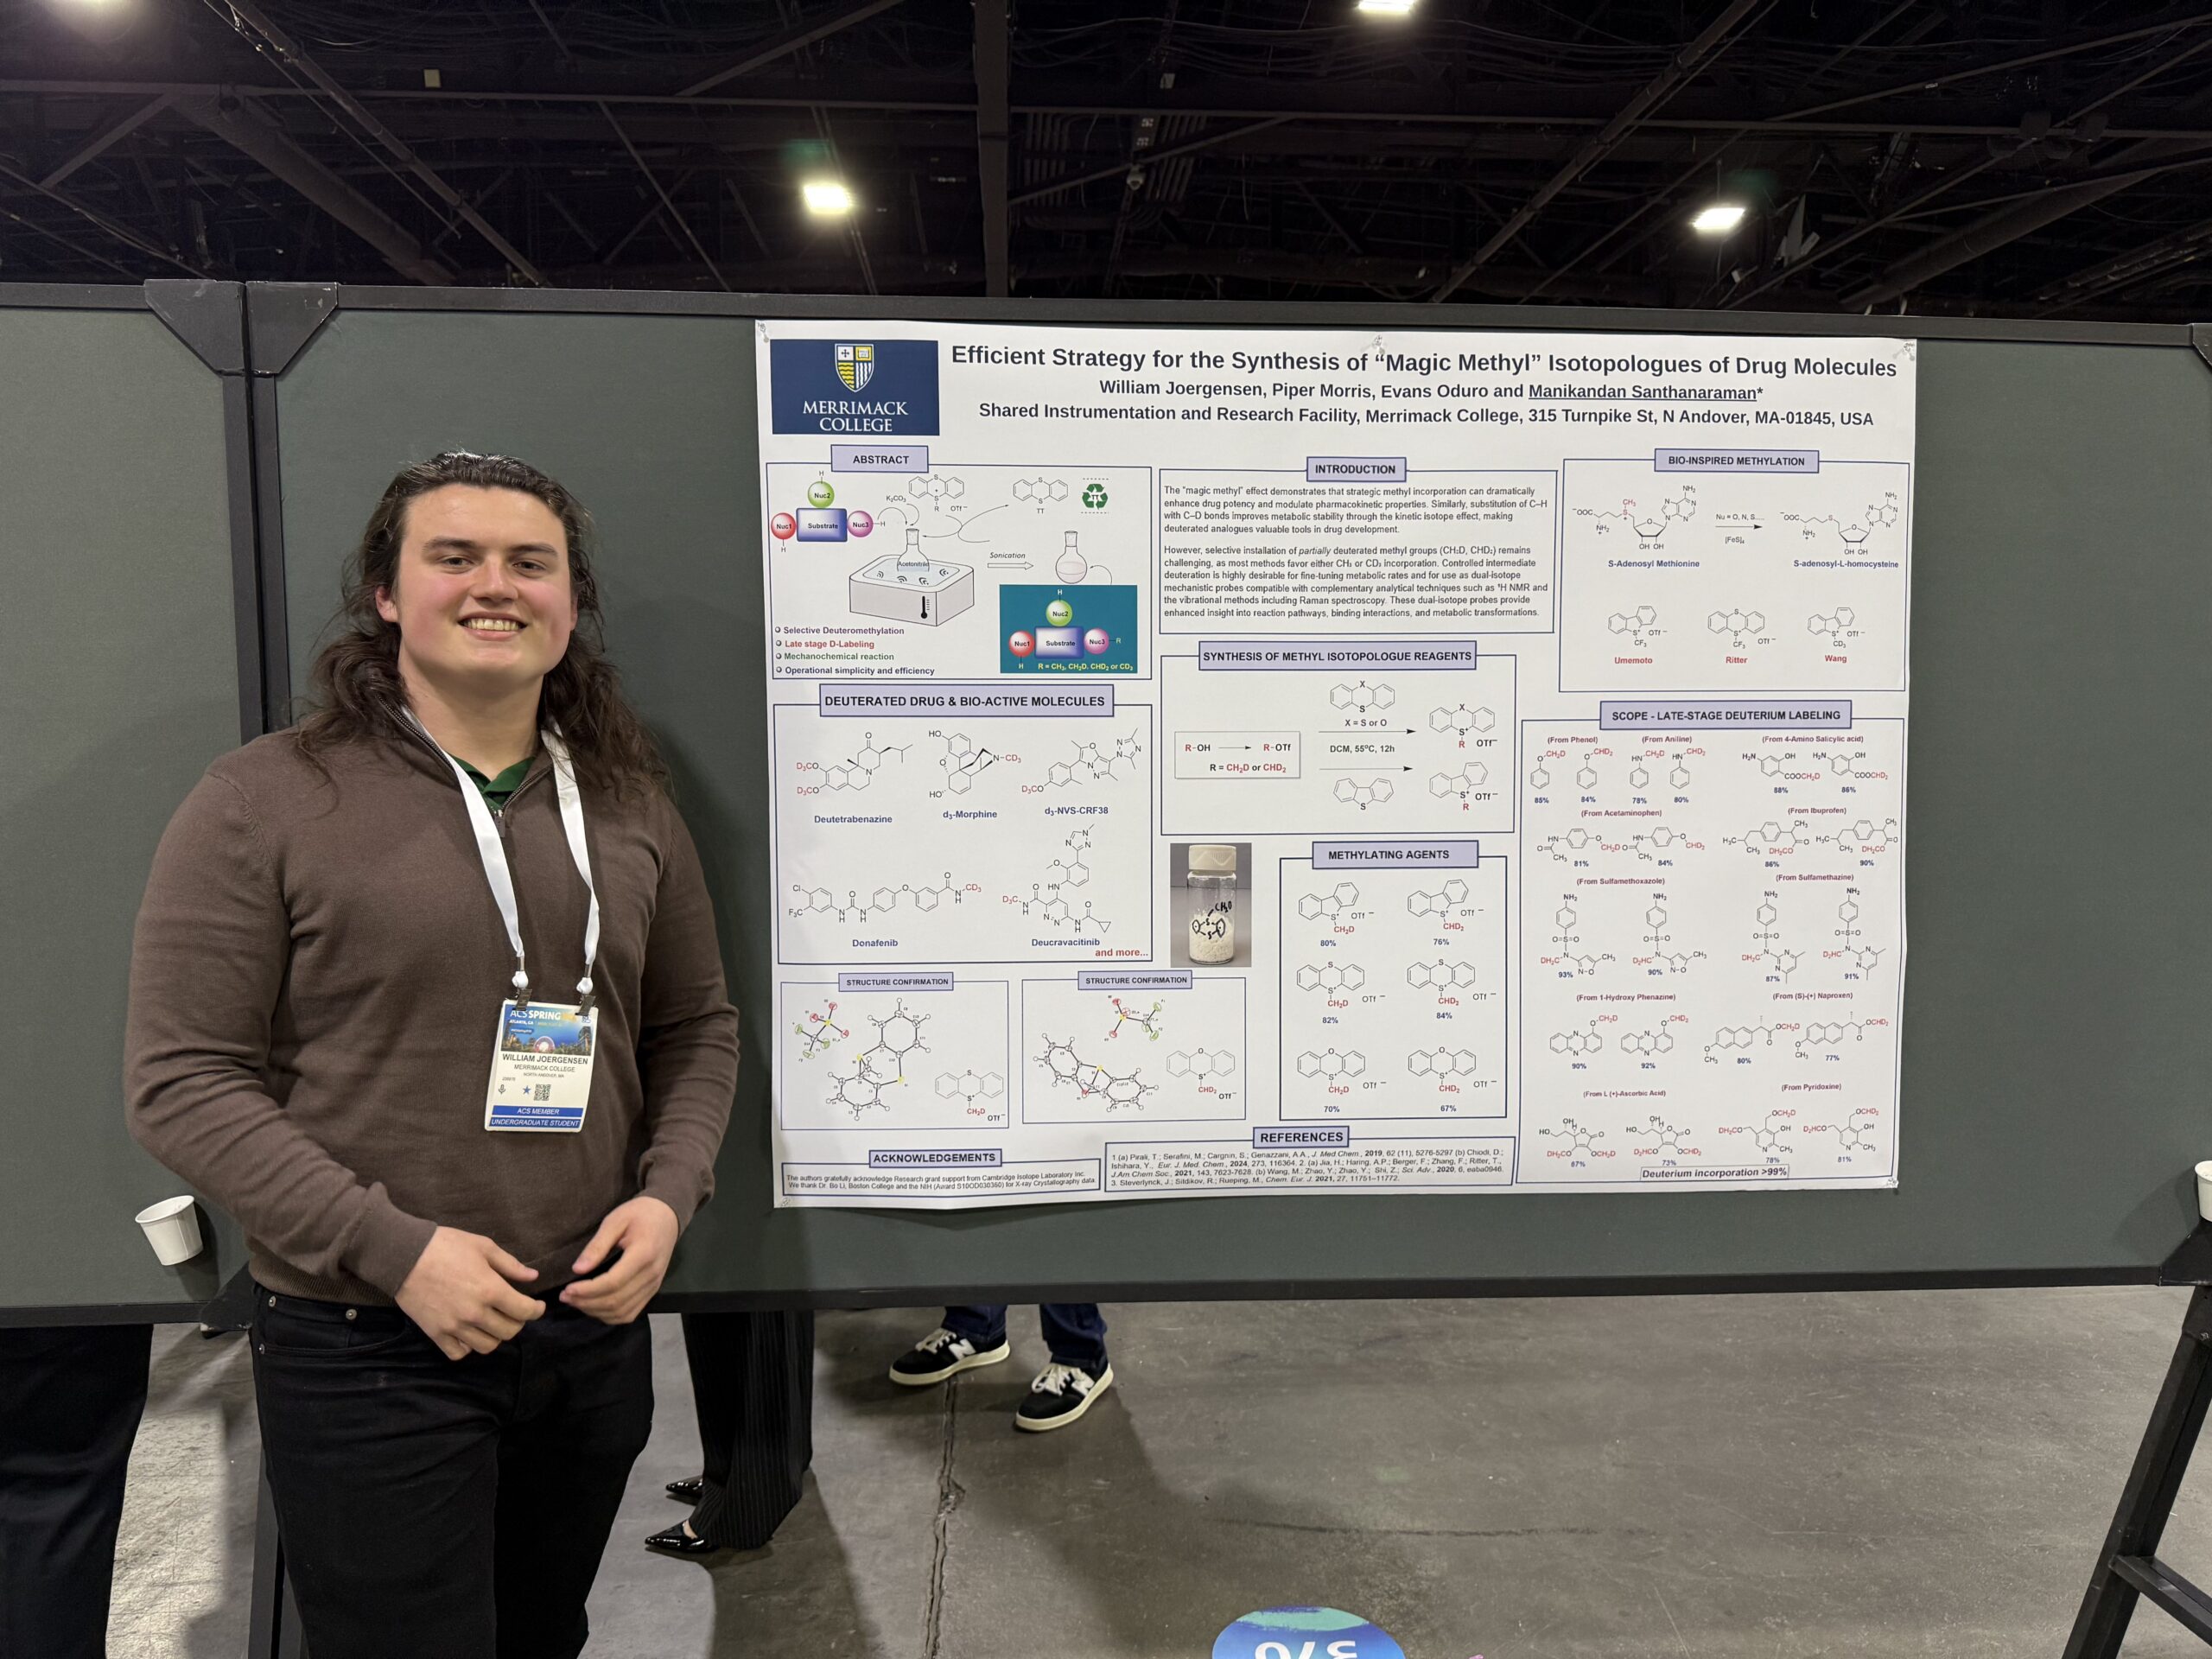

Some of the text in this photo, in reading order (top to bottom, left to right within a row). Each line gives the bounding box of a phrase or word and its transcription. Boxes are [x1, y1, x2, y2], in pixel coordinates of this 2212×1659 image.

[952, 345, 1046, 365] Efficient
[1052, 348, 1146, 372] Strategy
[1153, 349, 1183, 368] for
[1190, 350, 1224, 369] the
[1232, 351, 1339, 373] Synthesis
[1347, 353, 1368, 371] of
[1549, 354, 1701, 377] Isotopologues
[1709, 356, 1730, 373] of
[1737, 357, 1786, 378] Drug
[1794, 357, 1896, 377] Molecules
[1099, 379, 1160, 395] William
[1166, 381, 1267, 399] Joergensen,
[1273, 382, 1315, 400] Piper
[1320, 384, 1376, 401] Morris,
[1382, 385, 1431, 398] Evans
[1437, 385, 1488, 399] Oduro
[1493, 385, 1523, 398] and
[1529, 385, 1627, 399] Manikandan
[803, 400, 908, 416] MERRIMACK
[980, 402, 1039, 417] Shared
[1045, 404, 1175, 420] Instrumentation
[1181, 406, 1211, 420] and
[1217, 407, 1293, 422] Research
[1300, 408, 1360, 426] Facility,
[1366, 408, 1452, 423] Merrimack
[1457, 408, 1522, 425] College,
[1529, 408, 1556, 422] 315
[1561, 408, 1631, 426] Turnpike
[1637, 409, 1657, 425] St,
[1679, 409, 1749, 426] Andover,
[1756, 410, 1834, 428] MA-01845,
[1840, 412, 1873, 425] USA
[819, 416, 893, 433] COLLEGE
[853, 454, 909, 464] ABSTRACT
[1669, 455, 1804, 466] BIO-INSPIRED METHYLATION
[1315, 464, 1395, 474] INTRODUCTION
[1246, 486, 1268, 495] effect
[1346, 487, 1381, 498] strategic
[1383, 487, 1411, 497] methyl
[1414, 487, 1466, 497] incorporation
[1486, 486, 1535, 497] dramatically
[1165, 499, 1199, 507] enhance
[1203, 499, 1220, 509] drug
[1224, 500, 1255, 510] potency
[1316, 500, 1382, 510] pharmacokinetic
[1385, 500, 1428, 510] properties.
[1432, 499, 1468, 510] Similarly,
[1608, 559, 1654, 569] S-Adenosyl
[1794, 559, 1898, 569] S-adenosyl-L-homocysteine
[1204, 652, 1471, 661] SYNTHESIS OF METHYL ISOTOPOLOGUE REAGENTS
[1825, 654, 1847, 664] Wang
[785, 667, 832, 676] Operational
[835, 667, 874, 676] simplicity
[895, 667, 935, 676] efficiency
[824, 696, 1105, 707] DEUTERATED DRUG & BIO-ACTIVE MOLECULES
[1612, 711, 1648, 721] SCOPE
[1657, 711, 1722, 720] LATE-STAGE
[1726, 710, 1785, 720] DEUTERIUM
[1789, 710, 1840, 720] LABELING
[1548, 736, 1569, 745] (From
[1642, 735, 1692, 744] (From Aniline)
[1330, 745, 1351, 753] DCM,
[1581, 809, 1662, 818] (From Acetaminophen)
[1329, 849, 1449, 860] METHYLATING AGENTS
[1576, 878, 1598, 887] (From
[1776, 874, 1796, 882] (From
[852, 938, 898, 947] Donafenib
[1032, 938, 1100, 946] Deucravacitinib
[1095, 948, 1113, 957] and
[847, 977, 949, 986] STRUCTURE CONFIRMATION
[1085, 976, 1187, 985] STRUCTURE CONFIRMATION
[529, 1010, 561, 1020] SPRING
[537, 1056, 588, 1065] JOERGENSEN
[1782, 1083, 1841, 1092] (From Pyridoxine)
[1261, 1133, 1344, 1142] REFERENCES
[874, 1154, 995, 1162] ACKNOWLEDGEMENTS
[1643, 1166, 1787, 1179] Deuterium incorporation >99%
